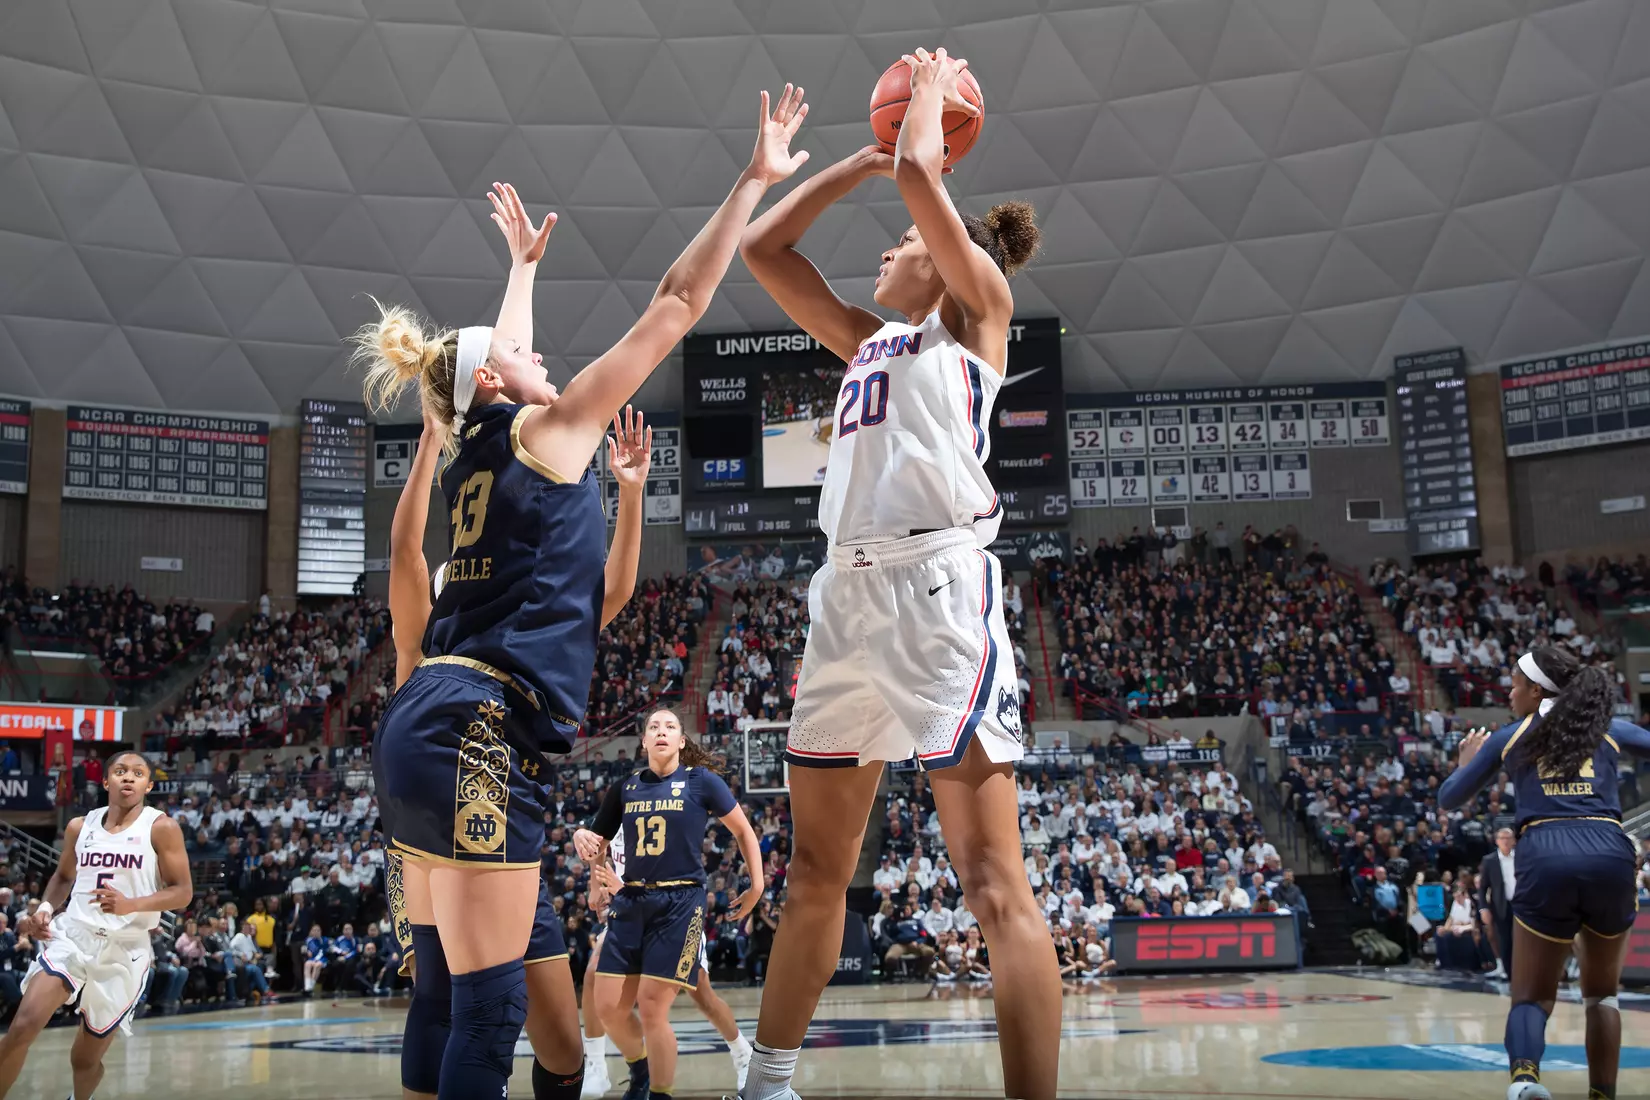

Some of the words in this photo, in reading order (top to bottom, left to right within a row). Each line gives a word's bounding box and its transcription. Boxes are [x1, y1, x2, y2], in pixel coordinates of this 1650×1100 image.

[1511, 359, 1559, 375] NCAA
[700, 378, 746, 389] WELLS
[702, 390, 746, 402] FARGO
[1136, 392, 1179, 402] UCONN
[1185, 388, 1241, 400] HUSKIES
[1247, 389, 1264, 398] OF
[1270, 387, 1314, 397] HONOR
[839, 370, 890, 439] 20
[79, 409, 125, 422] NCAA
[133, 413, 258, 432] CHAMPIONSHIP
[1361, 419, 1378, 436] 50
[77, 421, 163, 437] TOURNAMENT
[169, 430, 260, 443] APPEARANCES
[1154, 427, 1180, 444] 00
[1196, 426, 1219, 443] 13
[1235, 424, 1262, 441] 42
[1279, 423, 1296, 439] 34
[1321, 421, 1337, 438] 32
[159, 438, 180, 453] 1957
[1074, 431, 1100, 448] 52
[651, 449, 676, 466] 42
[998, 458, 1044, 469] TRAVELERS
[186, 459, 208, 474] 1976
[215, 461, 236, 476] 1979
[384, 461, 400, 477] C
[1082, 480, 1096, 497] 15
[1121, 479, 1138, 496] 22
[1202, 475, 1219, 493] 42
[1242, 473, 1260, 491] 13
[1288, 472, 1296, 489] 3
[69, 489, 148, 501] CONNECTICUT
[192, 496, 260, 507] BASKETBALL
[1043, 495, 1067, 516] 25
[728, 522, 746, 531] FULL
[775, 520, 791, 530] SEC
[1176, 751, 1193, 760] SEC
[1198, 749, 1221, 761] 116
[1541, 782, 1595, 796] WALKER
[624, 801, 652, 814] NOTRE
[655, 799, 684, 812] DAME
[635, 815, 667, 857] 13
[80, 852, 143, 869] UCONN
[1136, 921, 1276, 960] ESPN
